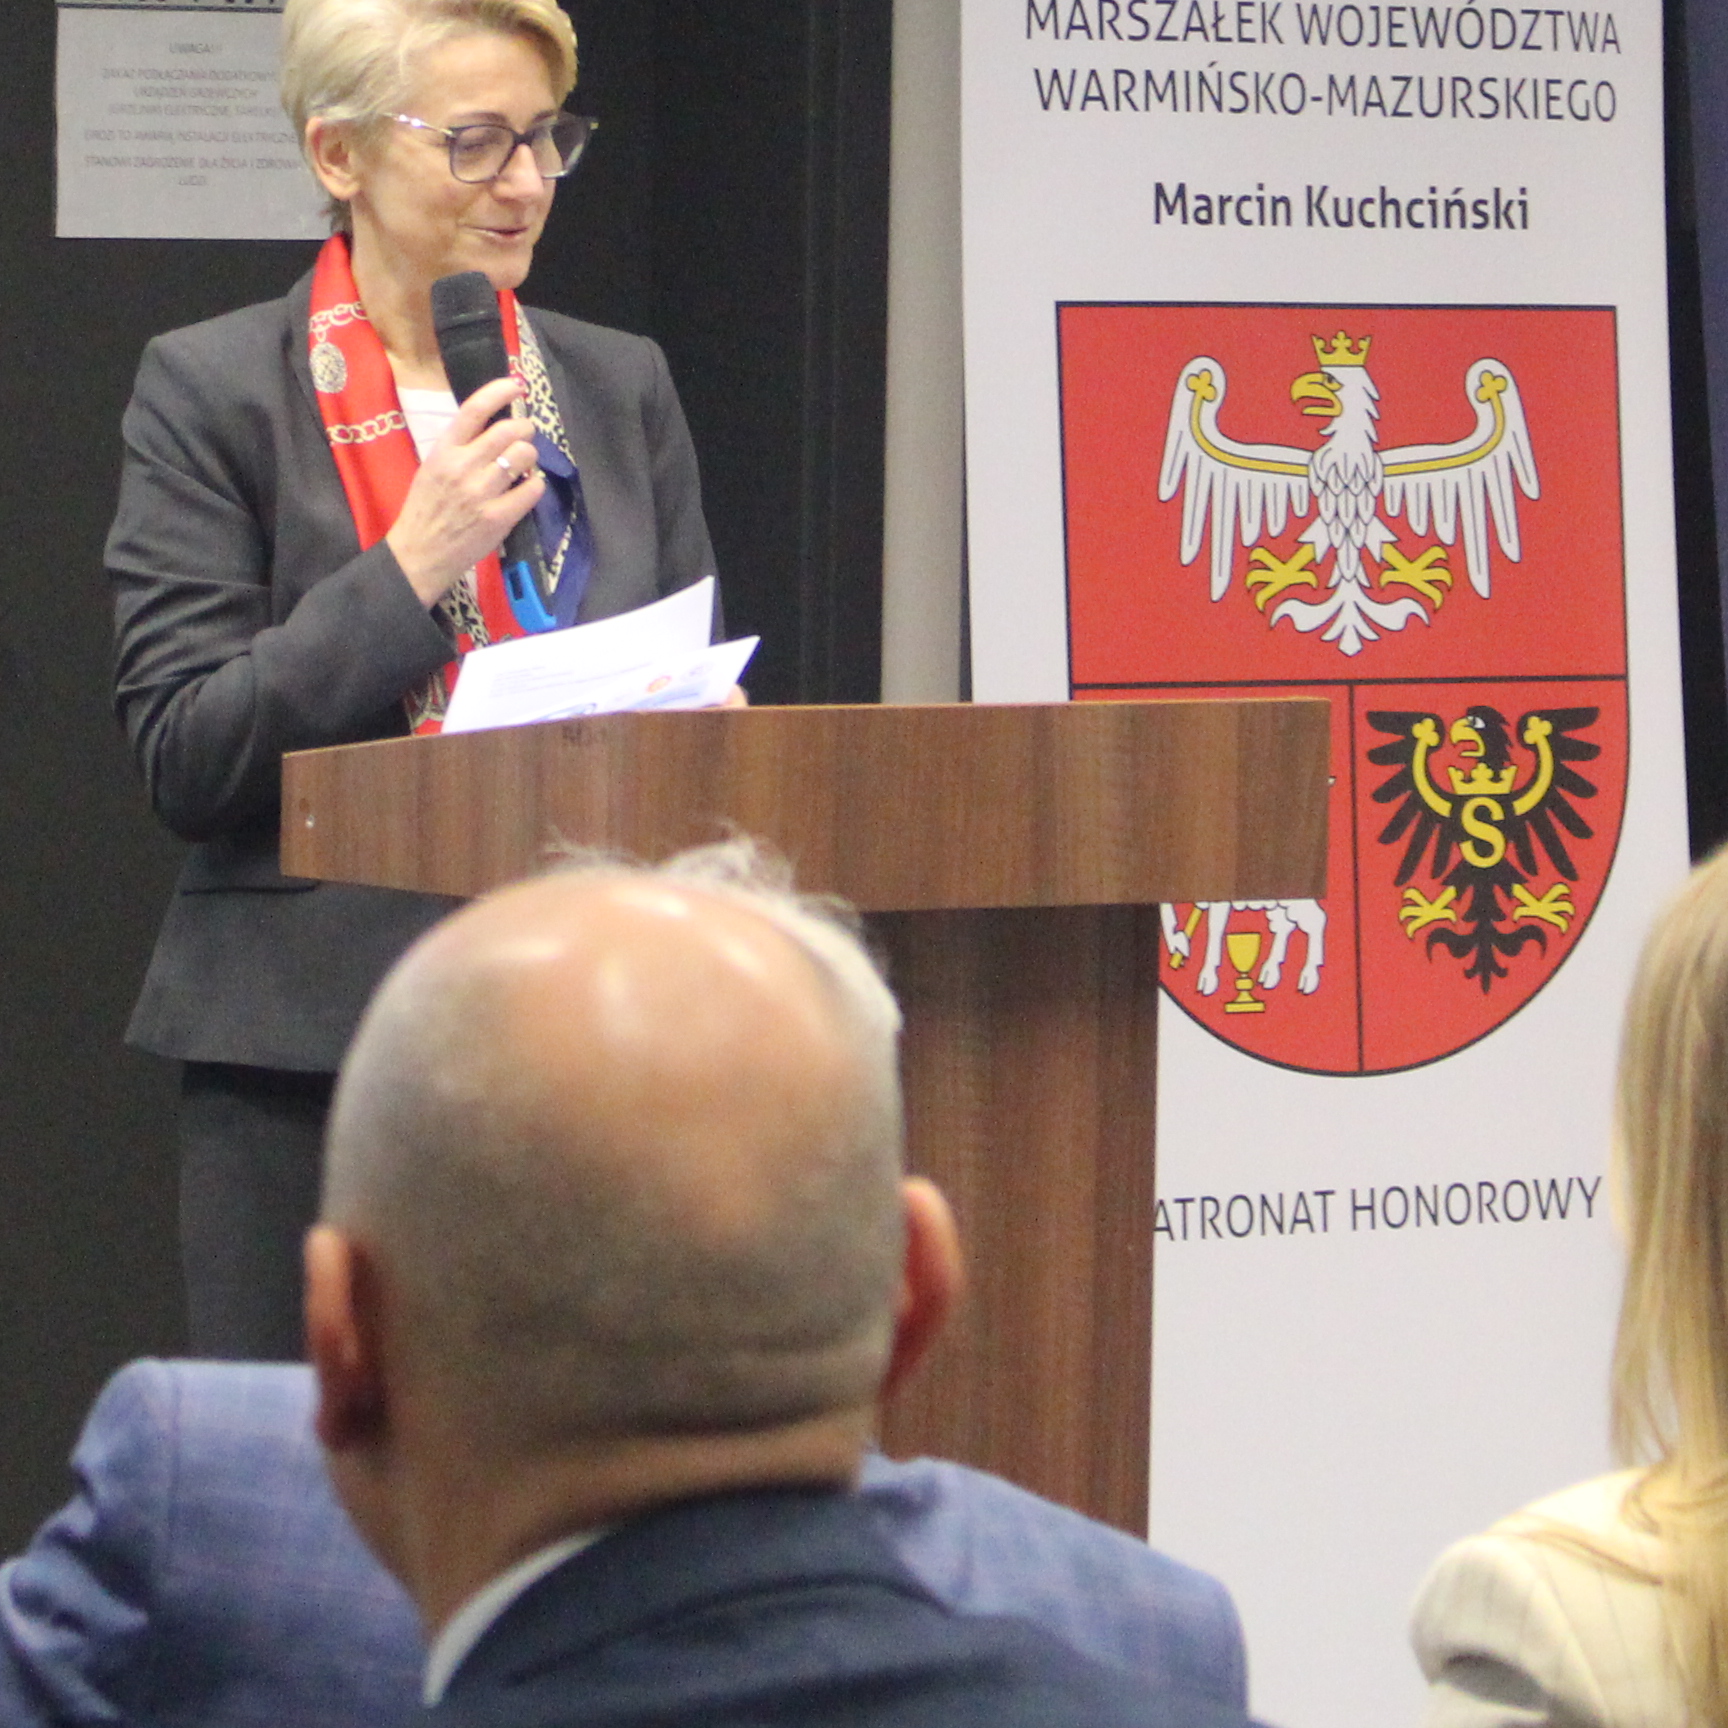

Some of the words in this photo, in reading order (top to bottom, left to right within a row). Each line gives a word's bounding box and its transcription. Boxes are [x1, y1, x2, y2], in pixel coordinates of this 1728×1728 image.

[1033, 60, 1617, 123] WARMIŃSKO-MAZURSKIEGO
[1154, 181, 1292, 227] Marcin
[1305, 184, 1529, 231] Kuchciński
[1459, 797, 1507, 869] S
[1153, 1189, 1337, 1242] ATRONAT
[1350, 1175, 1602, 1232] HONOROWY
